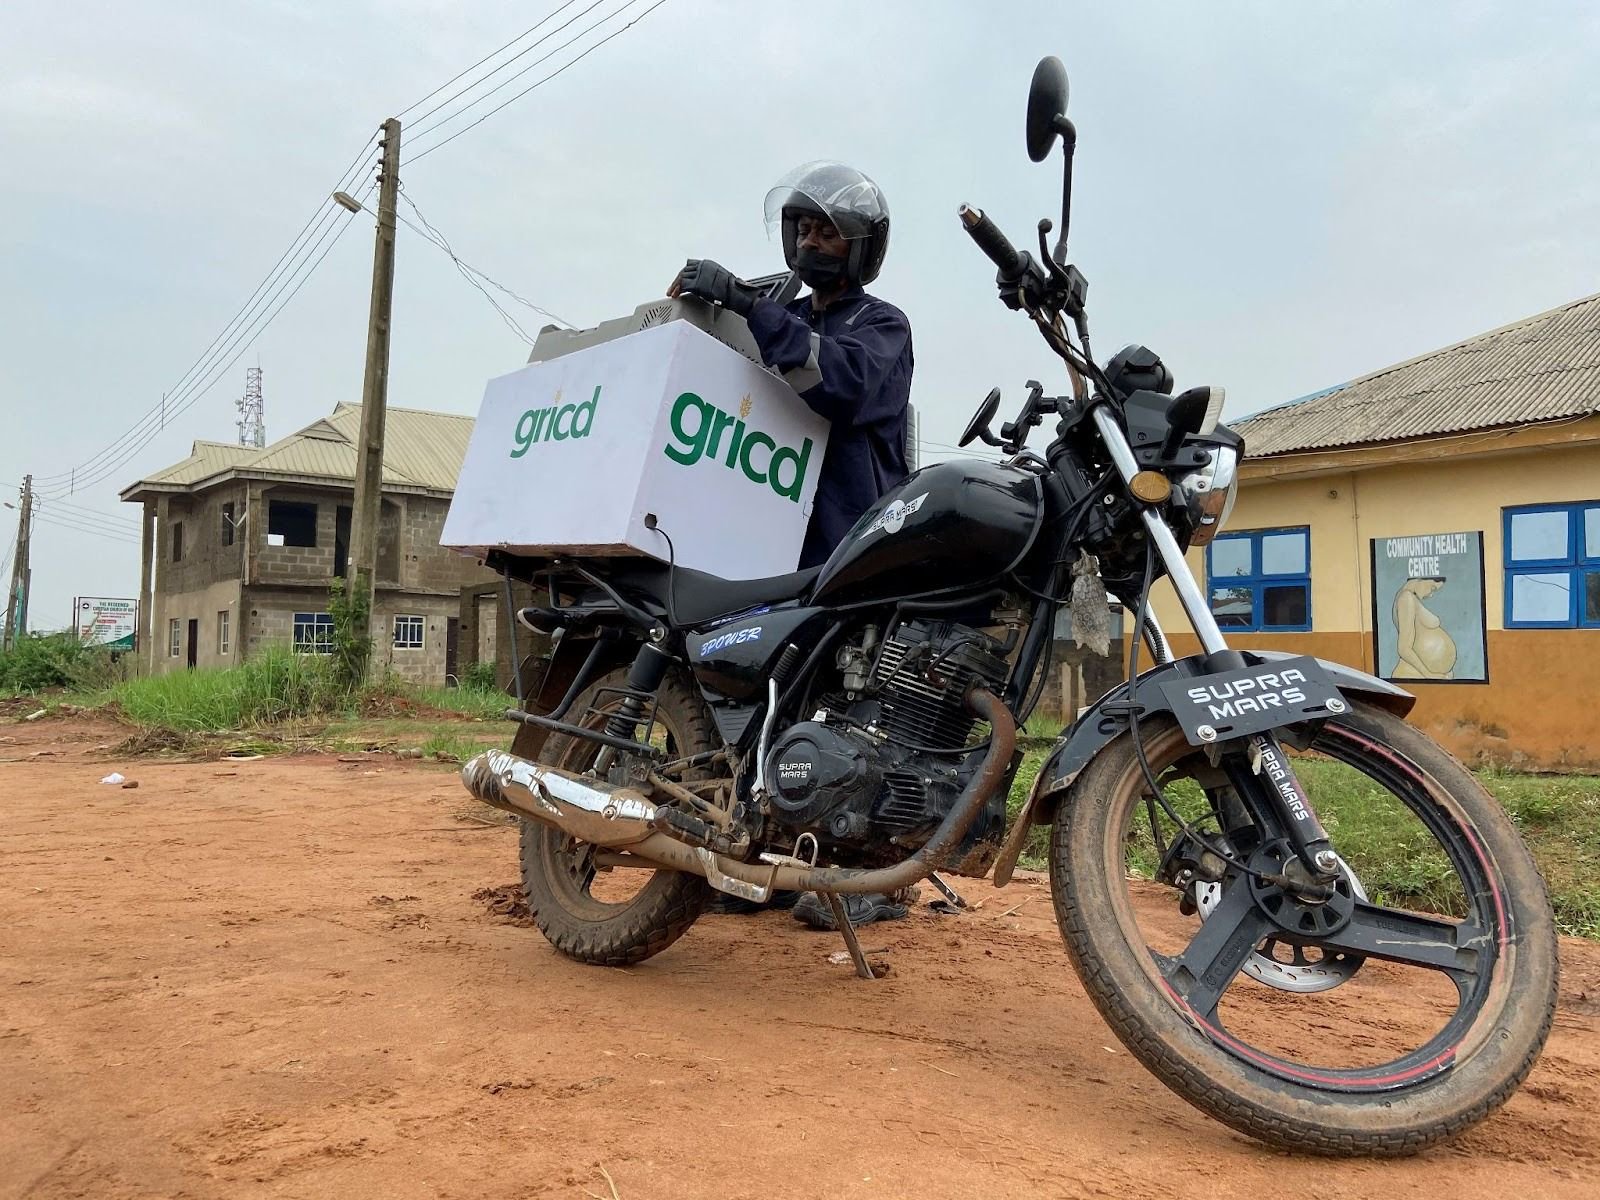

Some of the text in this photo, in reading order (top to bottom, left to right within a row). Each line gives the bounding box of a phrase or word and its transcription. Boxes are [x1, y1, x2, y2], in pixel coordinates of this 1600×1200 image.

[509, 385, 602, 458] gricd
[664, 392, 813, 503] gricd
[873, 513, 895, 530] SUPRA
[1386, 533, 1467, 558] COMMUNITY HEALTH
[1408, 556, 1440, 577] CENTRE
[700, 626, 762, 657] 3POWER
[1187, 668, 1307, 704] SUPRA
[1207, 687, 1307, 720] MARS
[778, 762, 812, 771] SUPRA
[780, 770, 808, 779] MARS
[1252, 735, 1310, 821] SUPRA MARS
